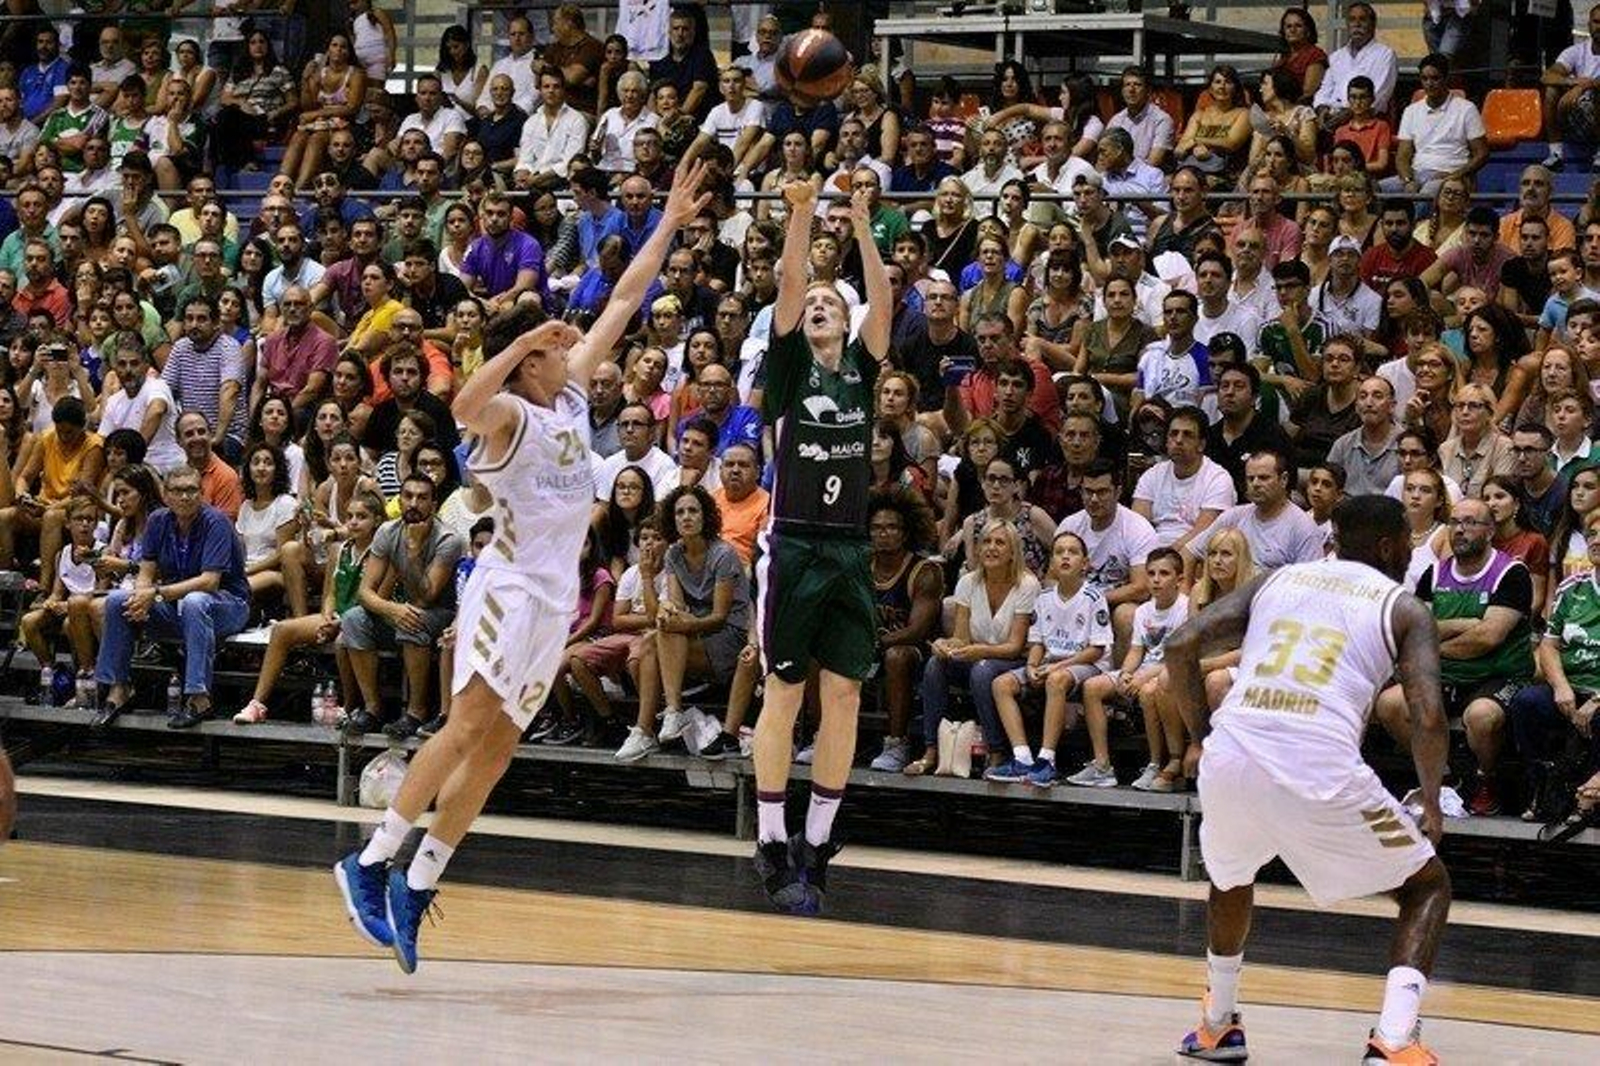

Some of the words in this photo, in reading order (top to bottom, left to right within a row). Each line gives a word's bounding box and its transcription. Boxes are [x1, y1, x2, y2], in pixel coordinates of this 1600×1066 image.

[823, 475, 842, 505] 9
[1255, 618, 1346, 687] 33
[1241, 686, 1320, 715] MADRID
